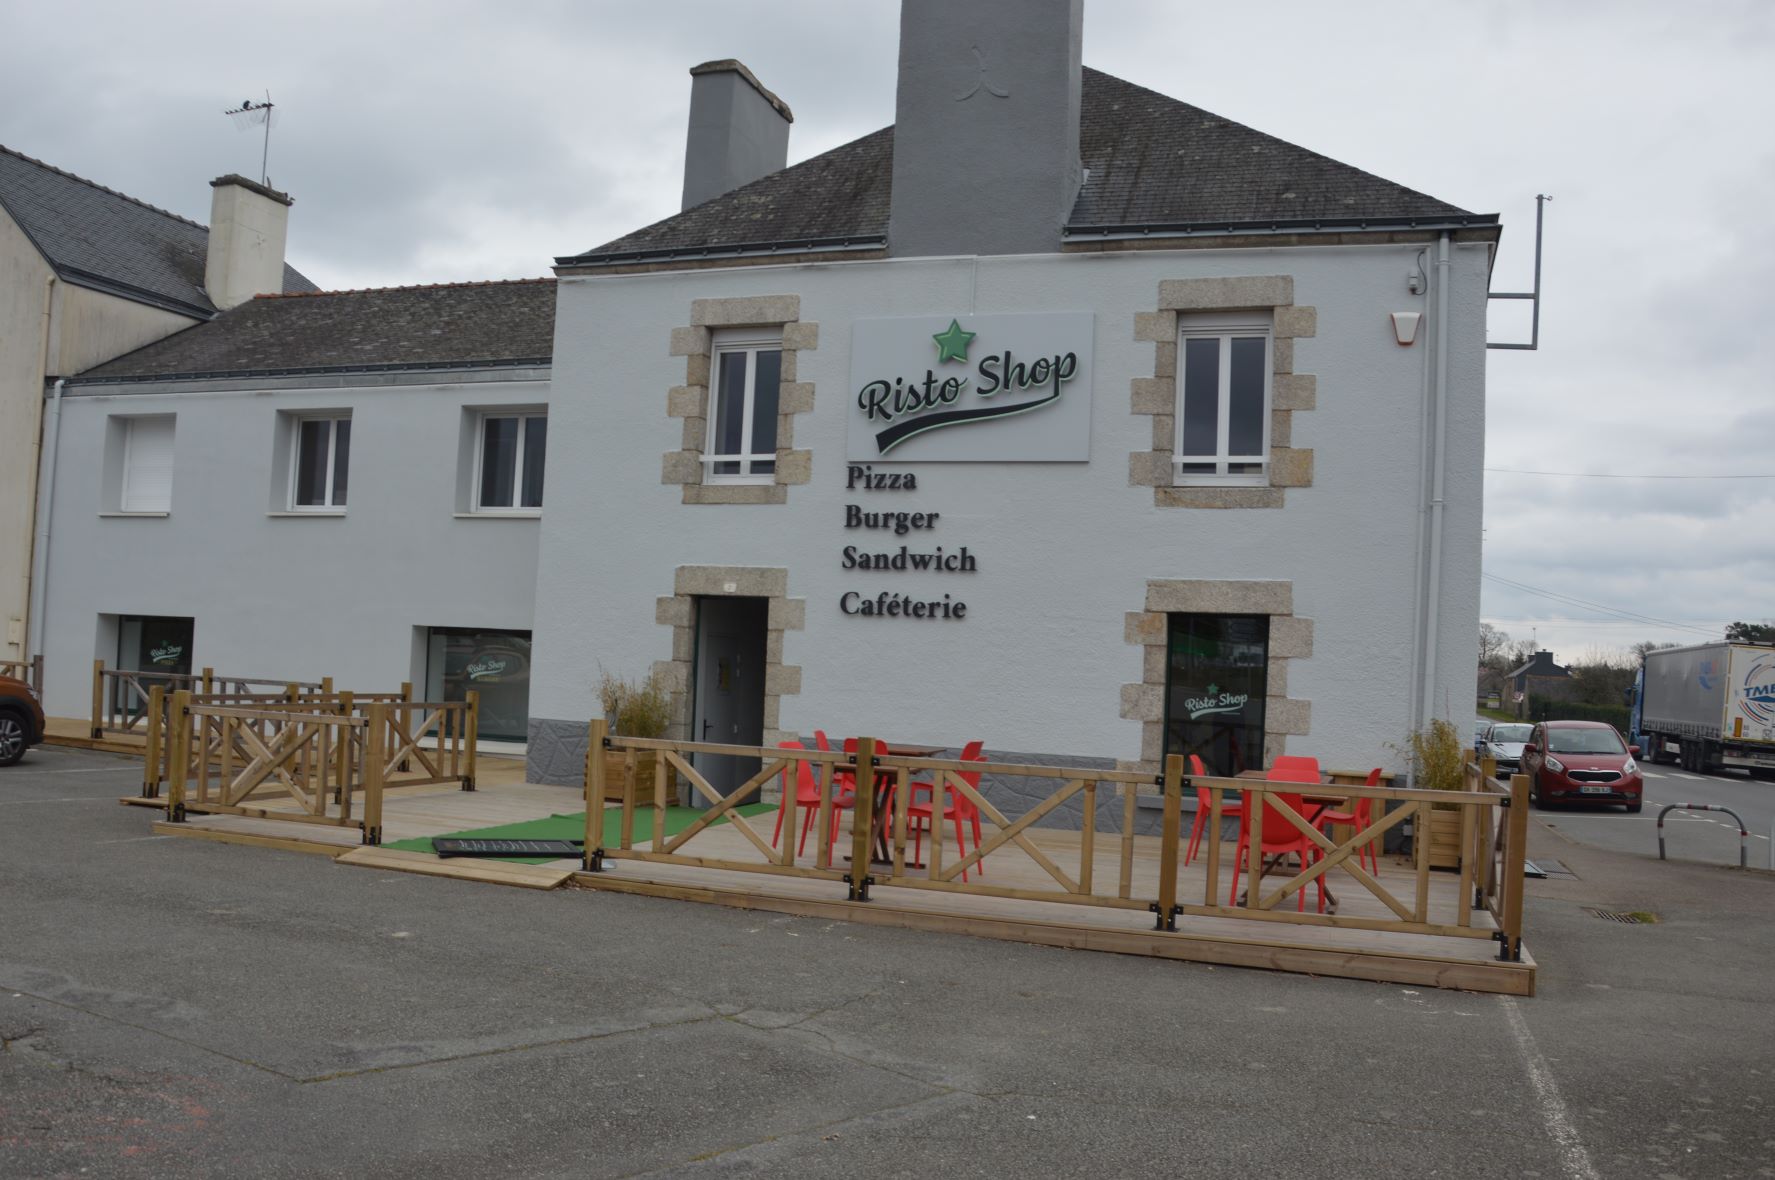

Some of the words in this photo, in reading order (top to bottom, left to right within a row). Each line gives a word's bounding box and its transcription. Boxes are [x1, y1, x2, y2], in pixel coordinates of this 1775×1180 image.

[857, 369, 968, 421] Risto
[976, 350, 1077, 398] Shop
[846, 465, 917, 490] Pizza
[844, 504, 940, 535] Burger
[841, 546, 977, 572] Sandwich
[840, 591, 968, 619] Caféterie
[1184, 696, 1217, 711] Risto
[1219, 692, 1248, 707] Shop
